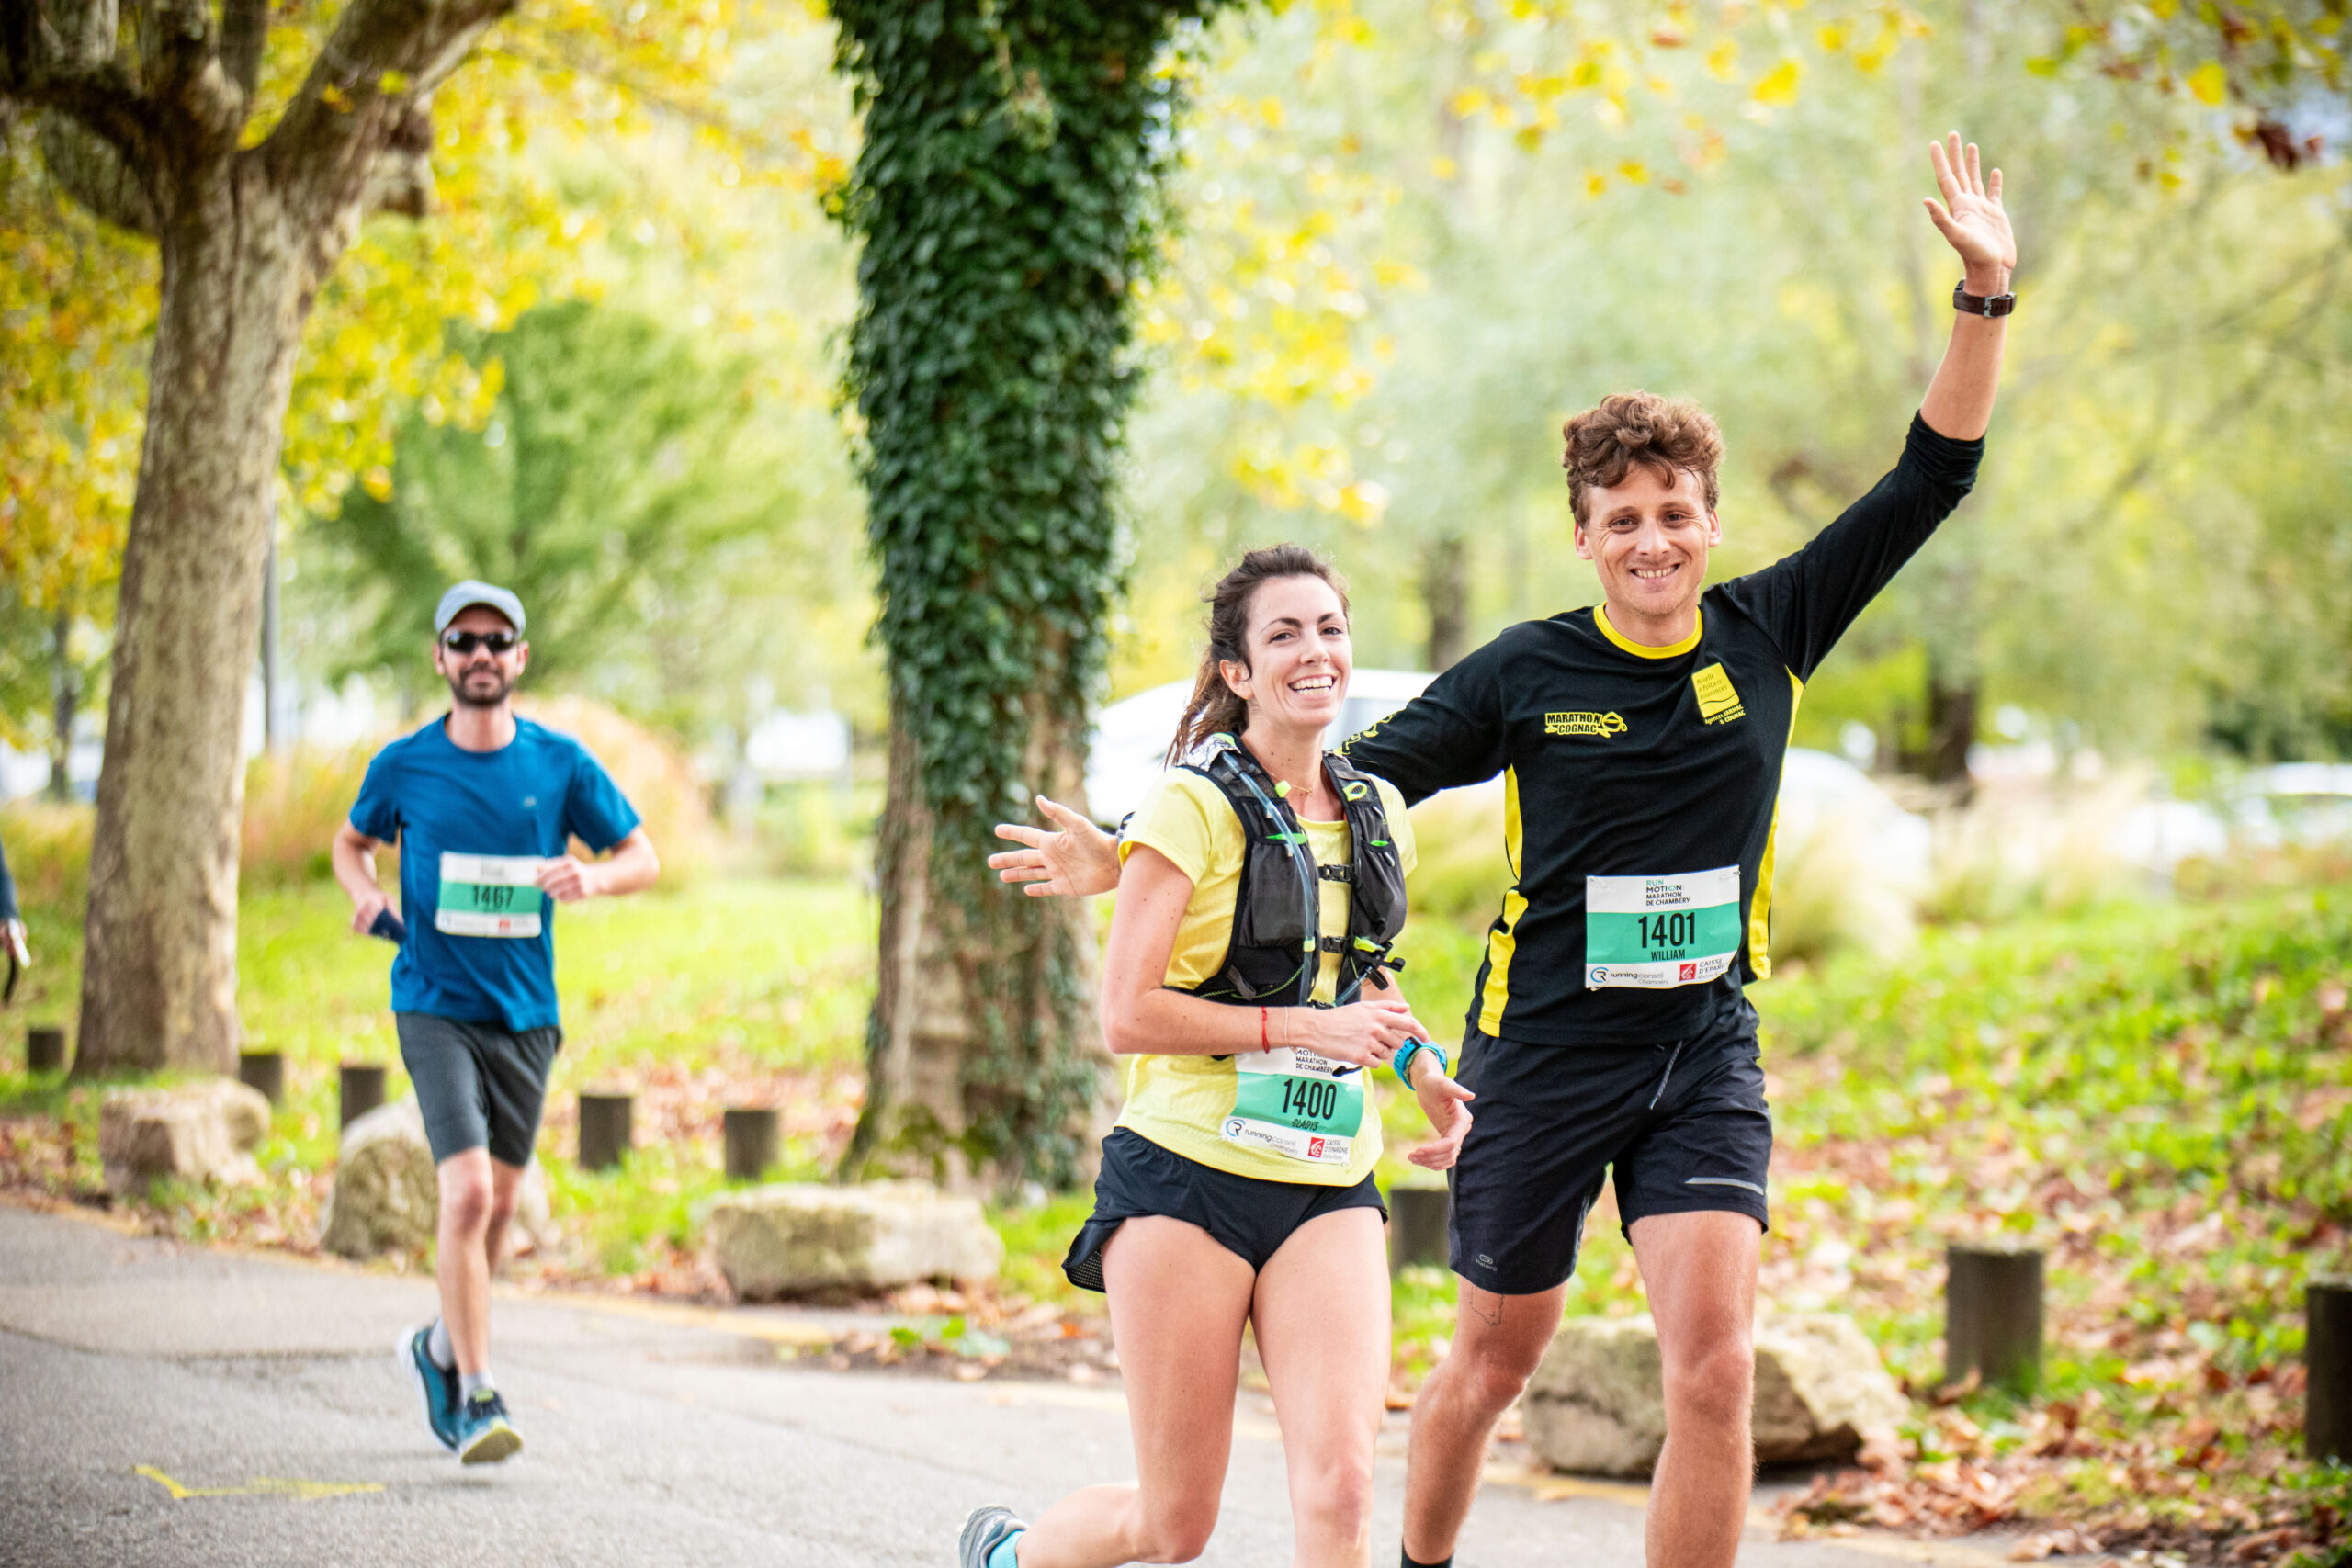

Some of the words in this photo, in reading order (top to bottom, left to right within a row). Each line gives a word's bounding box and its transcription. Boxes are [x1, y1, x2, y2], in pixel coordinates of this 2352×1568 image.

[1724, 704, 1744, 716] JARNAC
[1546, 713, 1603, 724] MARATHON
[1724, 709, 1746, 723] COGNAC
[1558, 724, 1598, 734] COGNAC
[1646, 885, 1682, 893] MOTION
[472, 884, 514, 908] 1467
[1656, 897, 1690, 906] CHAMBERY
[1638, 912, 1695, 948] 1401
[1651, 949, 1686, 961] WILLIAM
[1699, 958, 1722, 967] CAISSE
[1295, 1056, 1328, 1066] MARATHON
[1305, 1065, 1333, 1074] CHAMBERY
[1283, 1078, 1337, 1120] 1400
[1292, 1119, 1319, 1131] GLADYS
